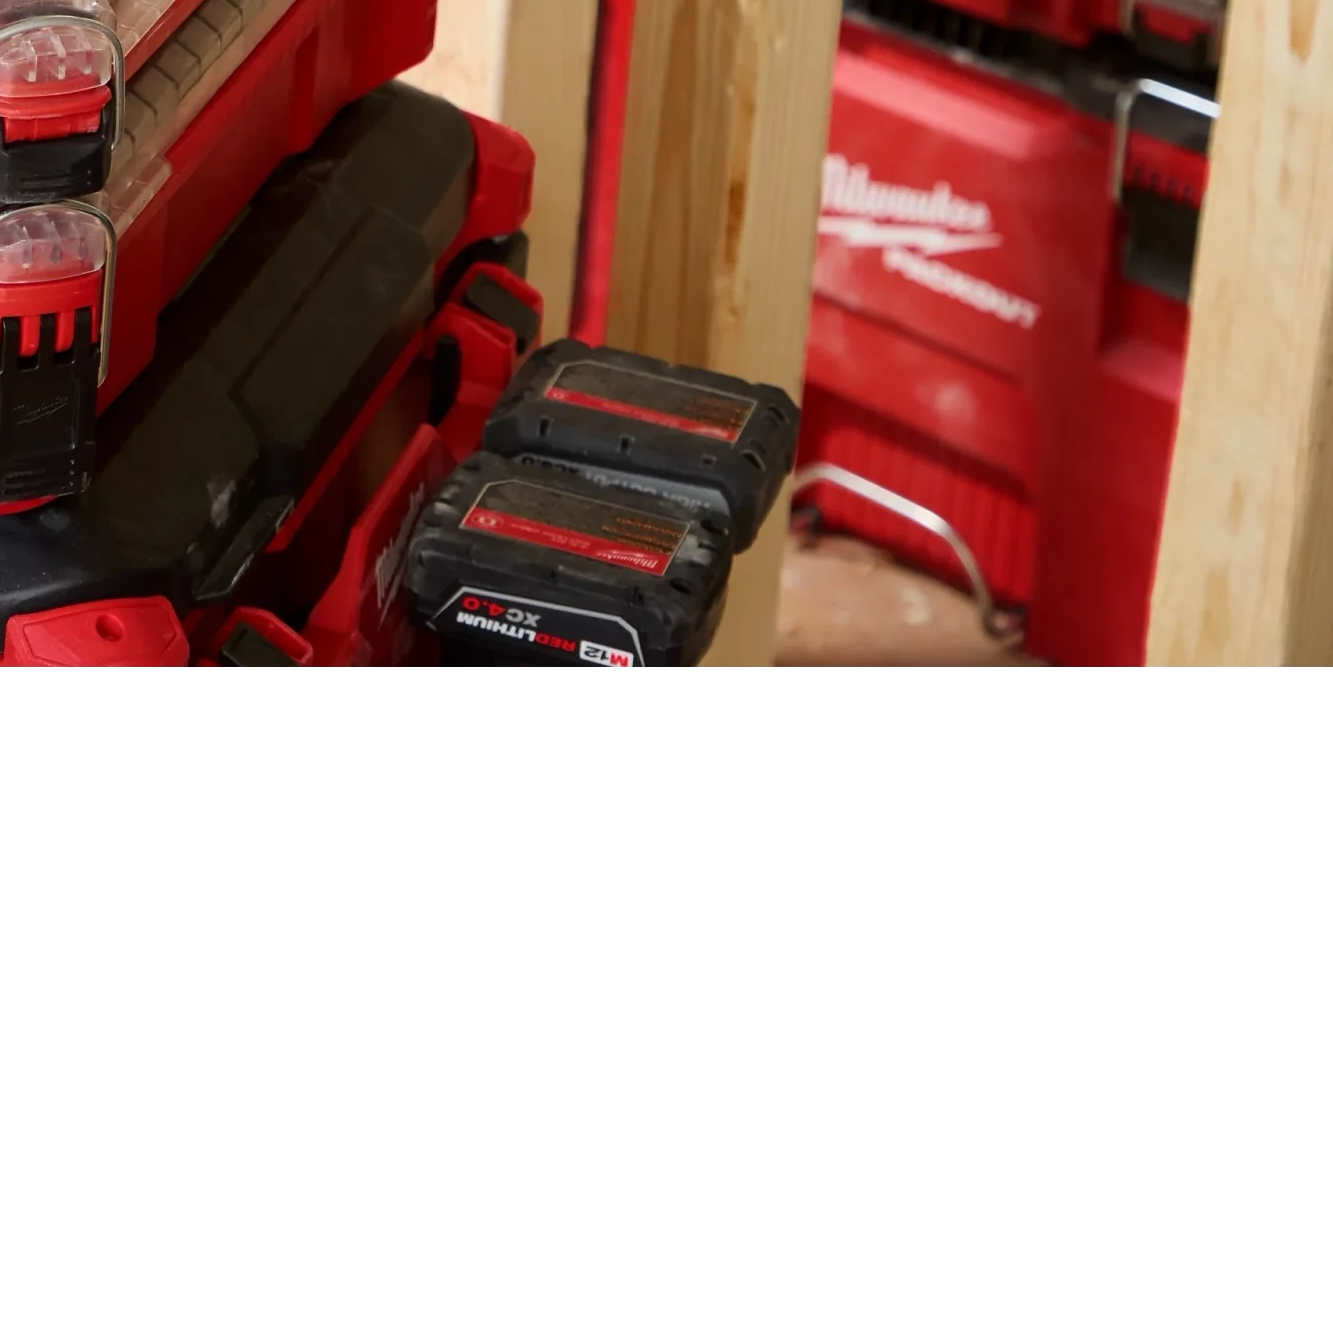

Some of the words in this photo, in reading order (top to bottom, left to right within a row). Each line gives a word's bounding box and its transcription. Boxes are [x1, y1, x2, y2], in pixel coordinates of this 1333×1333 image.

[462, 595, 541, 628] XC4.0
[456, 611, 577, 652] REDLITHIUM
[584, 646, 630, 668] M12
